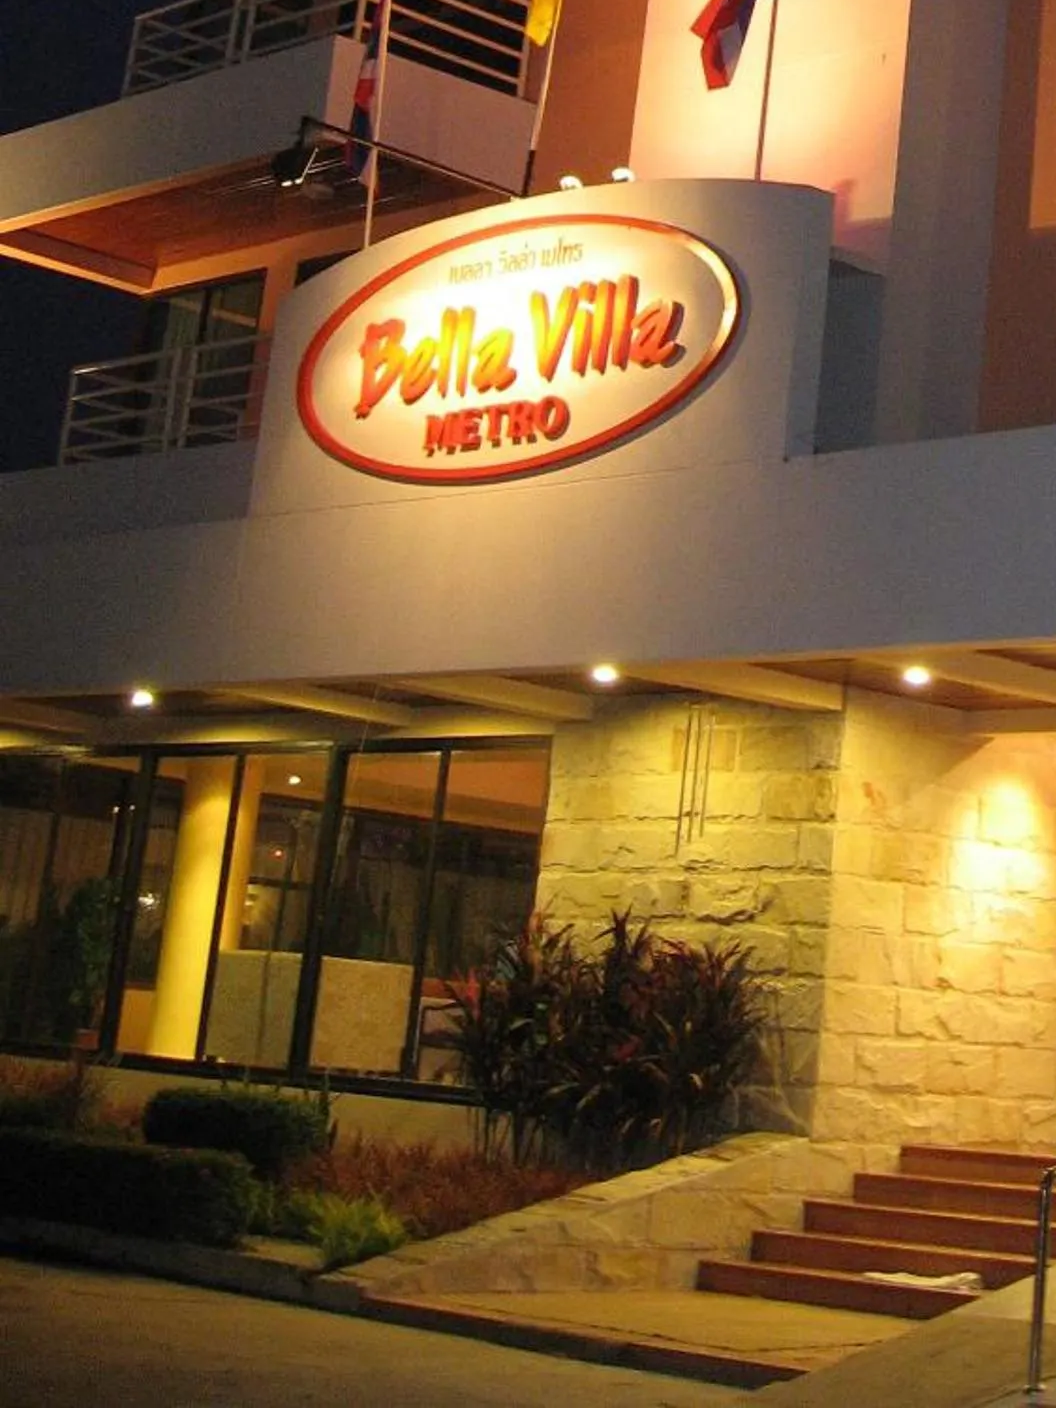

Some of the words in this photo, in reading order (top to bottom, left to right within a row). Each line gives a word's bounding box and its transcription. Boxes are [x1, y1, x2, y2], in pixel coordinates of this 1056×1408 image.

[354, 306, 518, 418] Bella
[529, 274, 686, 381] Villa
[423, 395, 571, 457] METRO
